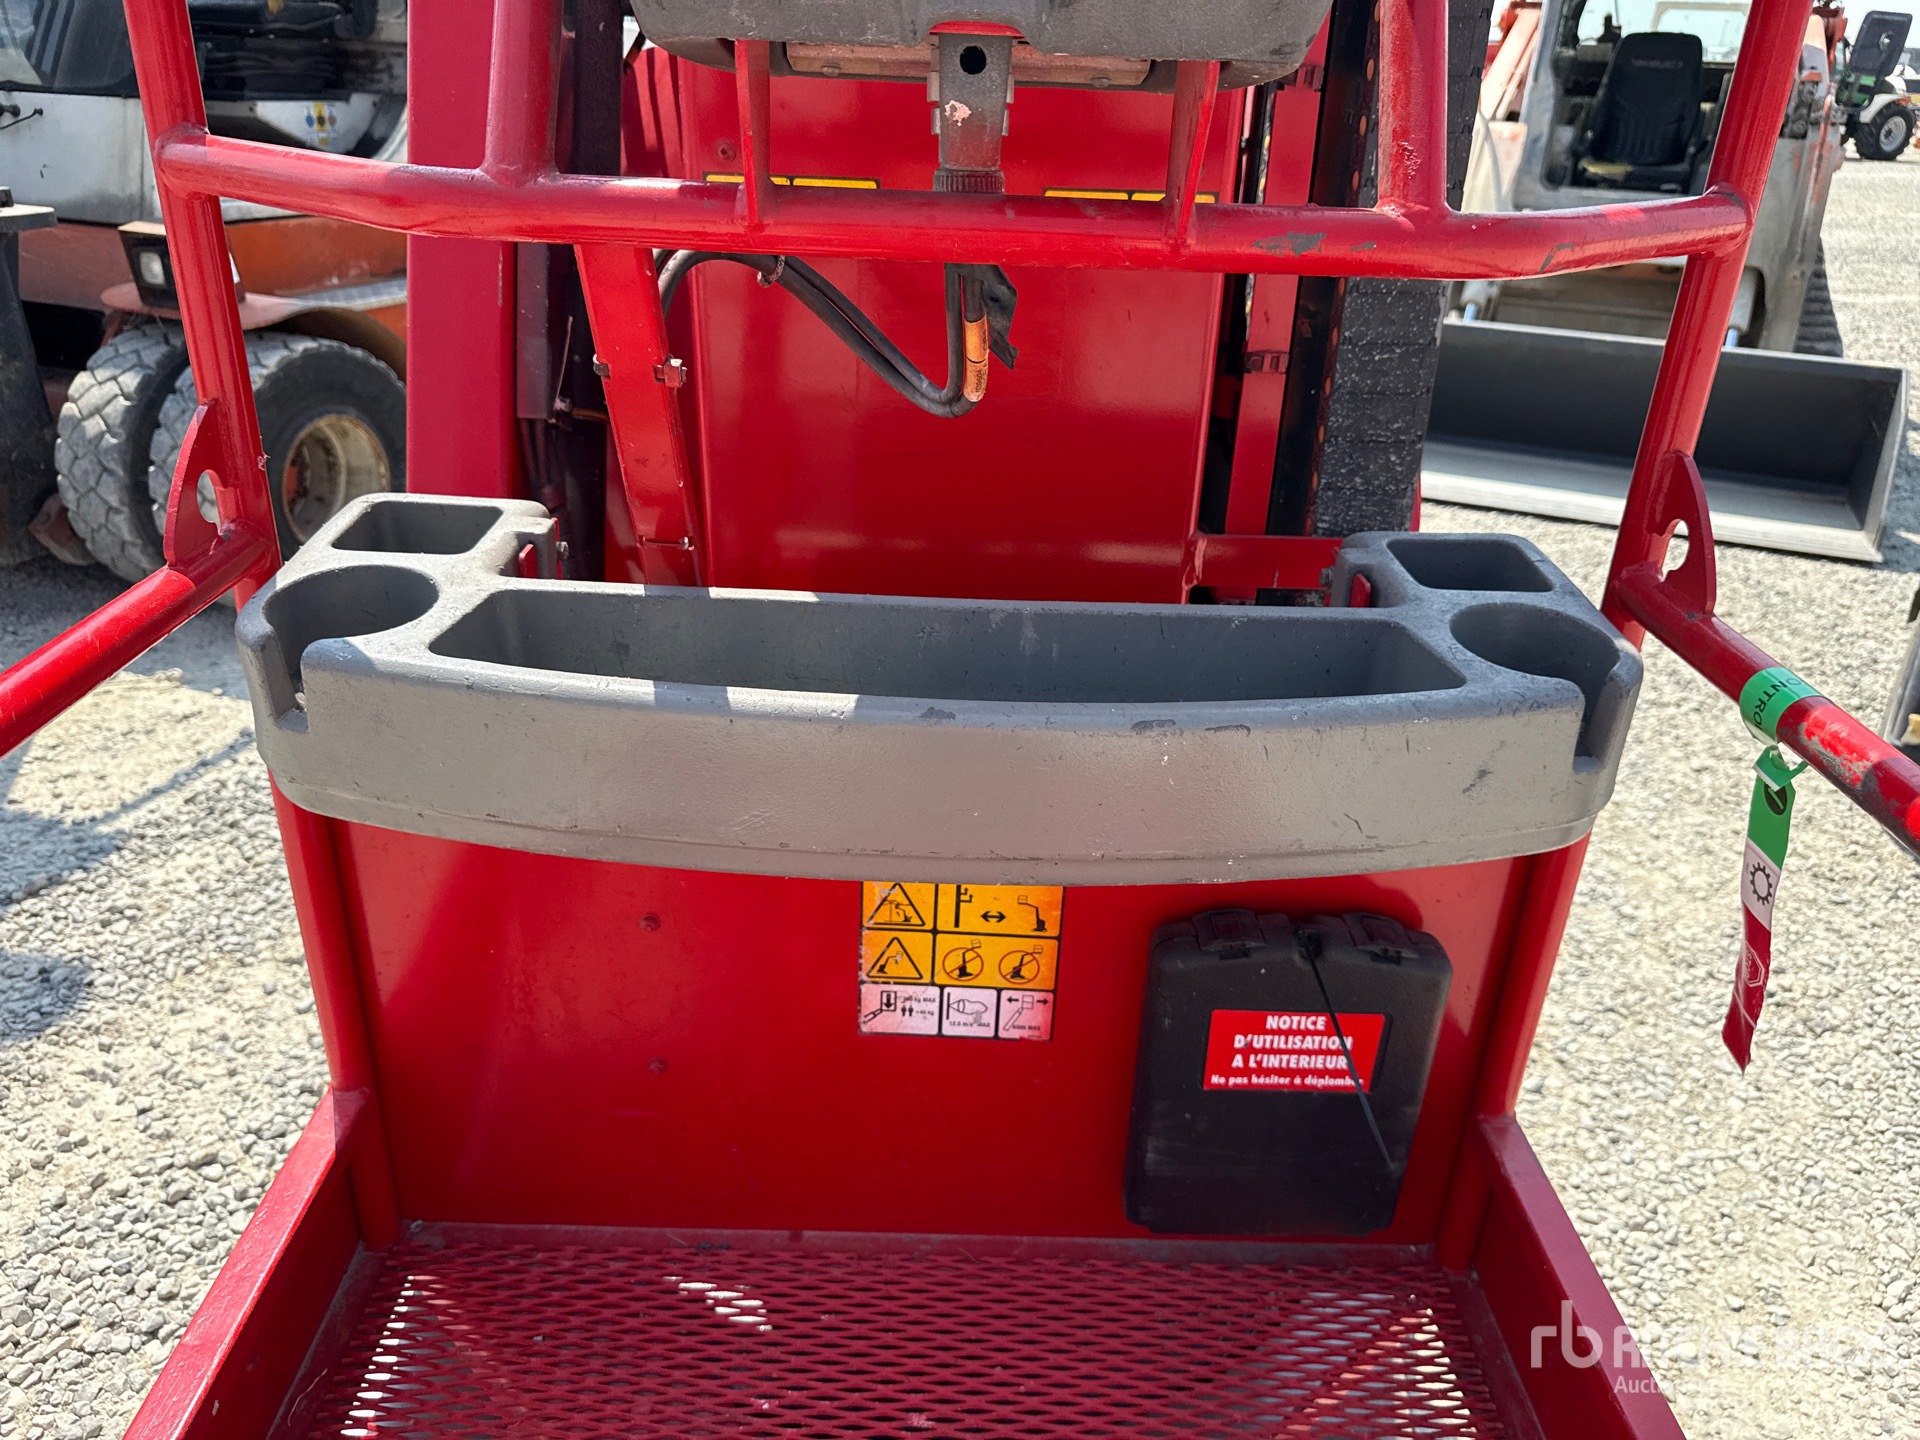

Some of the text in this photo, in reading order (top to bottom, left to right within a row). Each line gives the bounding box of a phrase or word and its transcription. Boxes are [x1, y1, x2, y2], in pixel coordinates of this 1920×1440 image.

[1752, 677, 1802, 732] ONTRO
[1266, 1015, 1327, 1030] NOTICE
[1233, 1034, 1353, 1050] D'UTILISATION
[1231, 1053, 1348, 1070] A L'INTERIEUR
[1210, 1074, 1226, 1084] Ne
[1228, 1076, 1249, 1088] pas
[1250, 1073, 1290, 1085] hésiter
